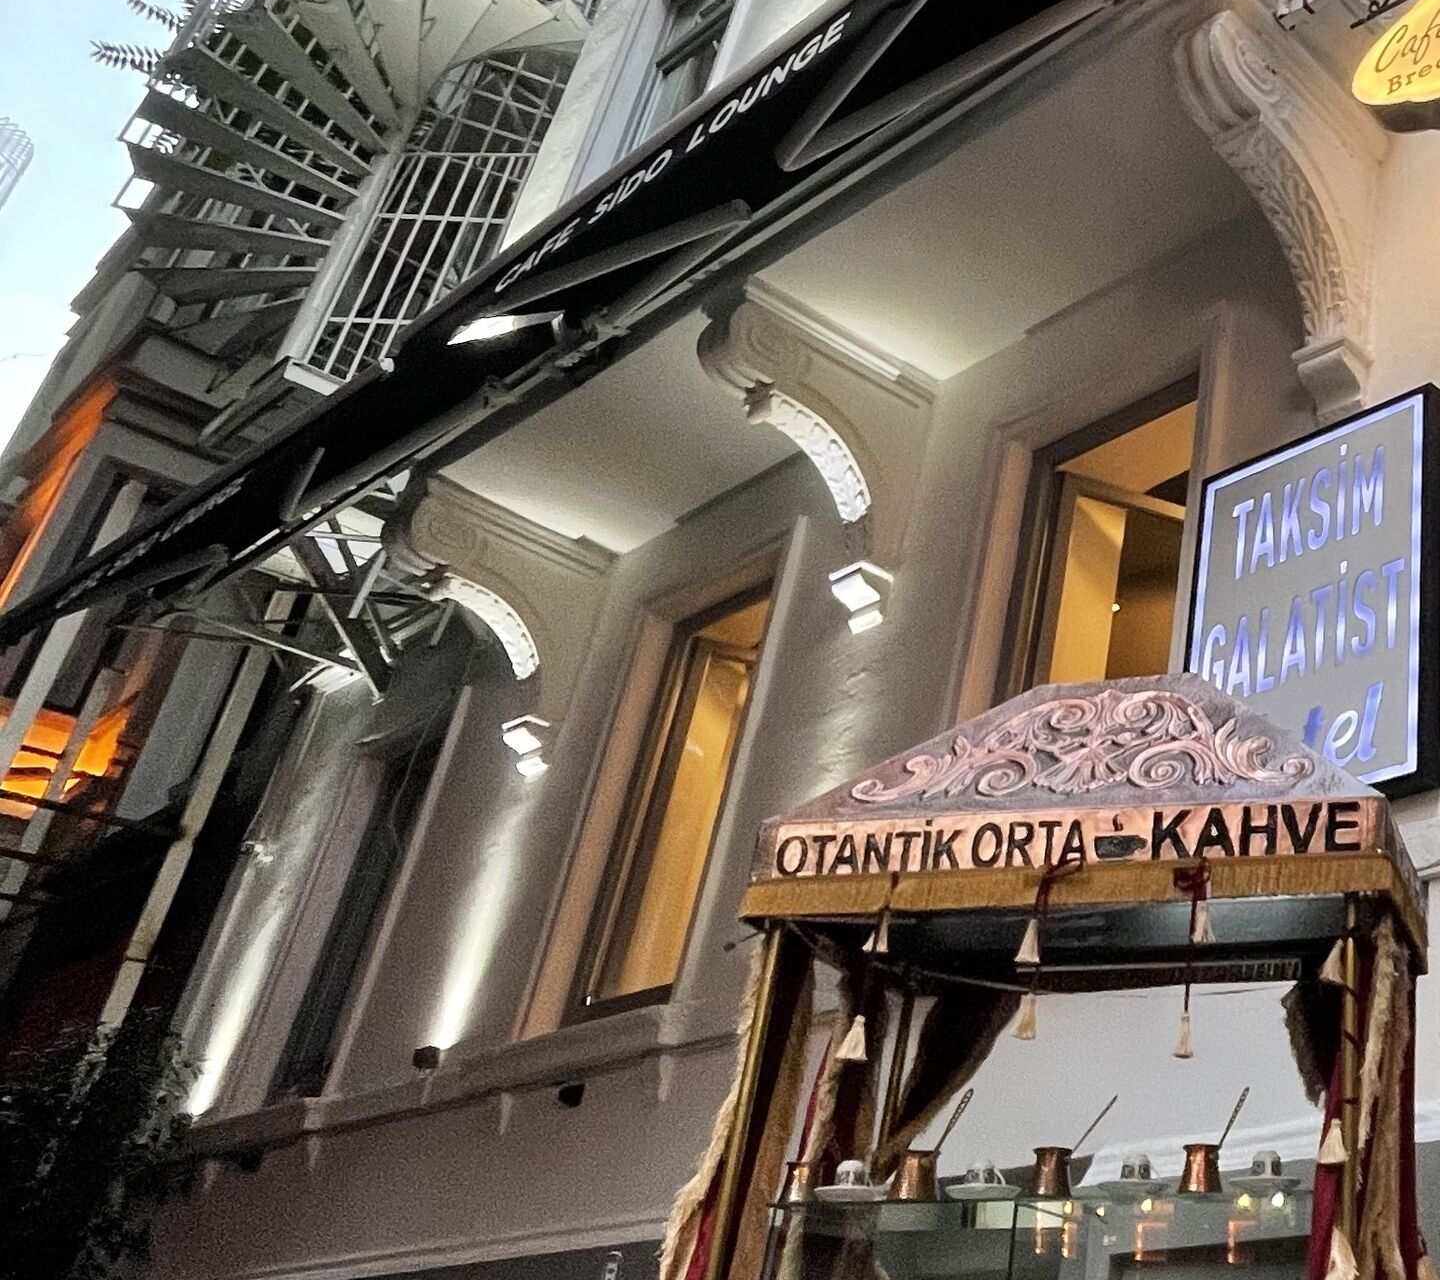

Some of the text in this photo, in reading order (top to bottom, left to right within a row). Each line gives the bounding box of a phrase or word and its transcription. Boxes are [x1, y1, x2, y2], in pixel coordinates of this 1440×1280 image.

[494, 217, 581, 294] CAFE
[685, 11, 852, 153] LOUNGE
[1231, 443, 1385, 580] TAKSİM
[1202, 559, 1405, 697] GALATİST
[971, 819, 1087, 870] ORTA
[1151, 801, 1361, 860] KAHVE
